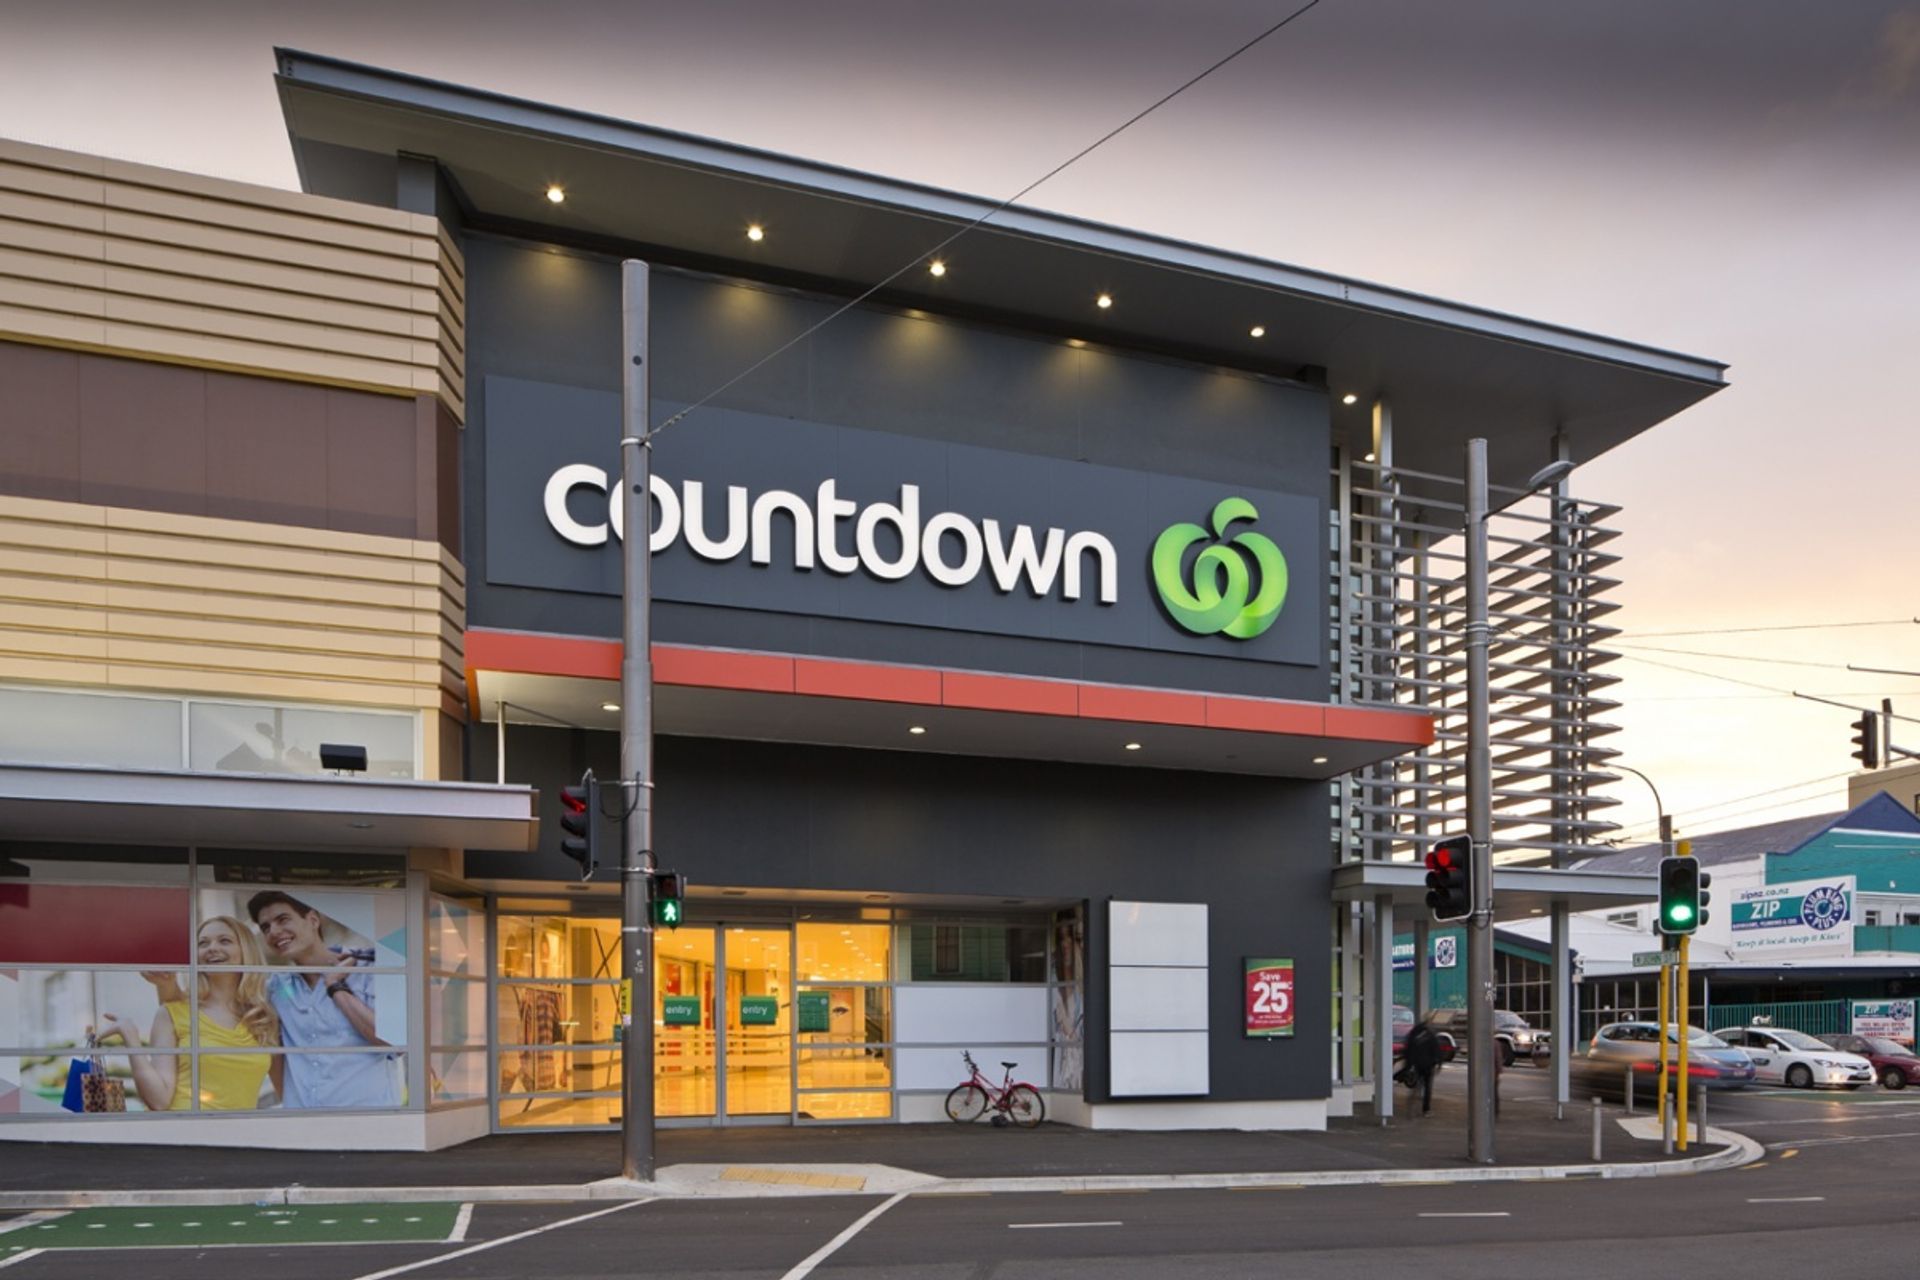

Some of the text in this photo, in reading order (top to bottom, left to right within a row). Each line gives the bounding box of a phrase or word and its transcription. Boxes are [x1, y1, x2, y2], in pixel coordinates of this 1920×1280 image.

[543, 463, 1118, 604] countdown
[1750, 900, 1780, 919] ZIP
[1811, 915, 1837, 929] PLUS
[1260, 971, 1281, 981] Save
[665, 1005, 692, 1016] entry
[742, 1005, 768, 1016] entry
[1864, 1005, 1880, 1014] ZIP
